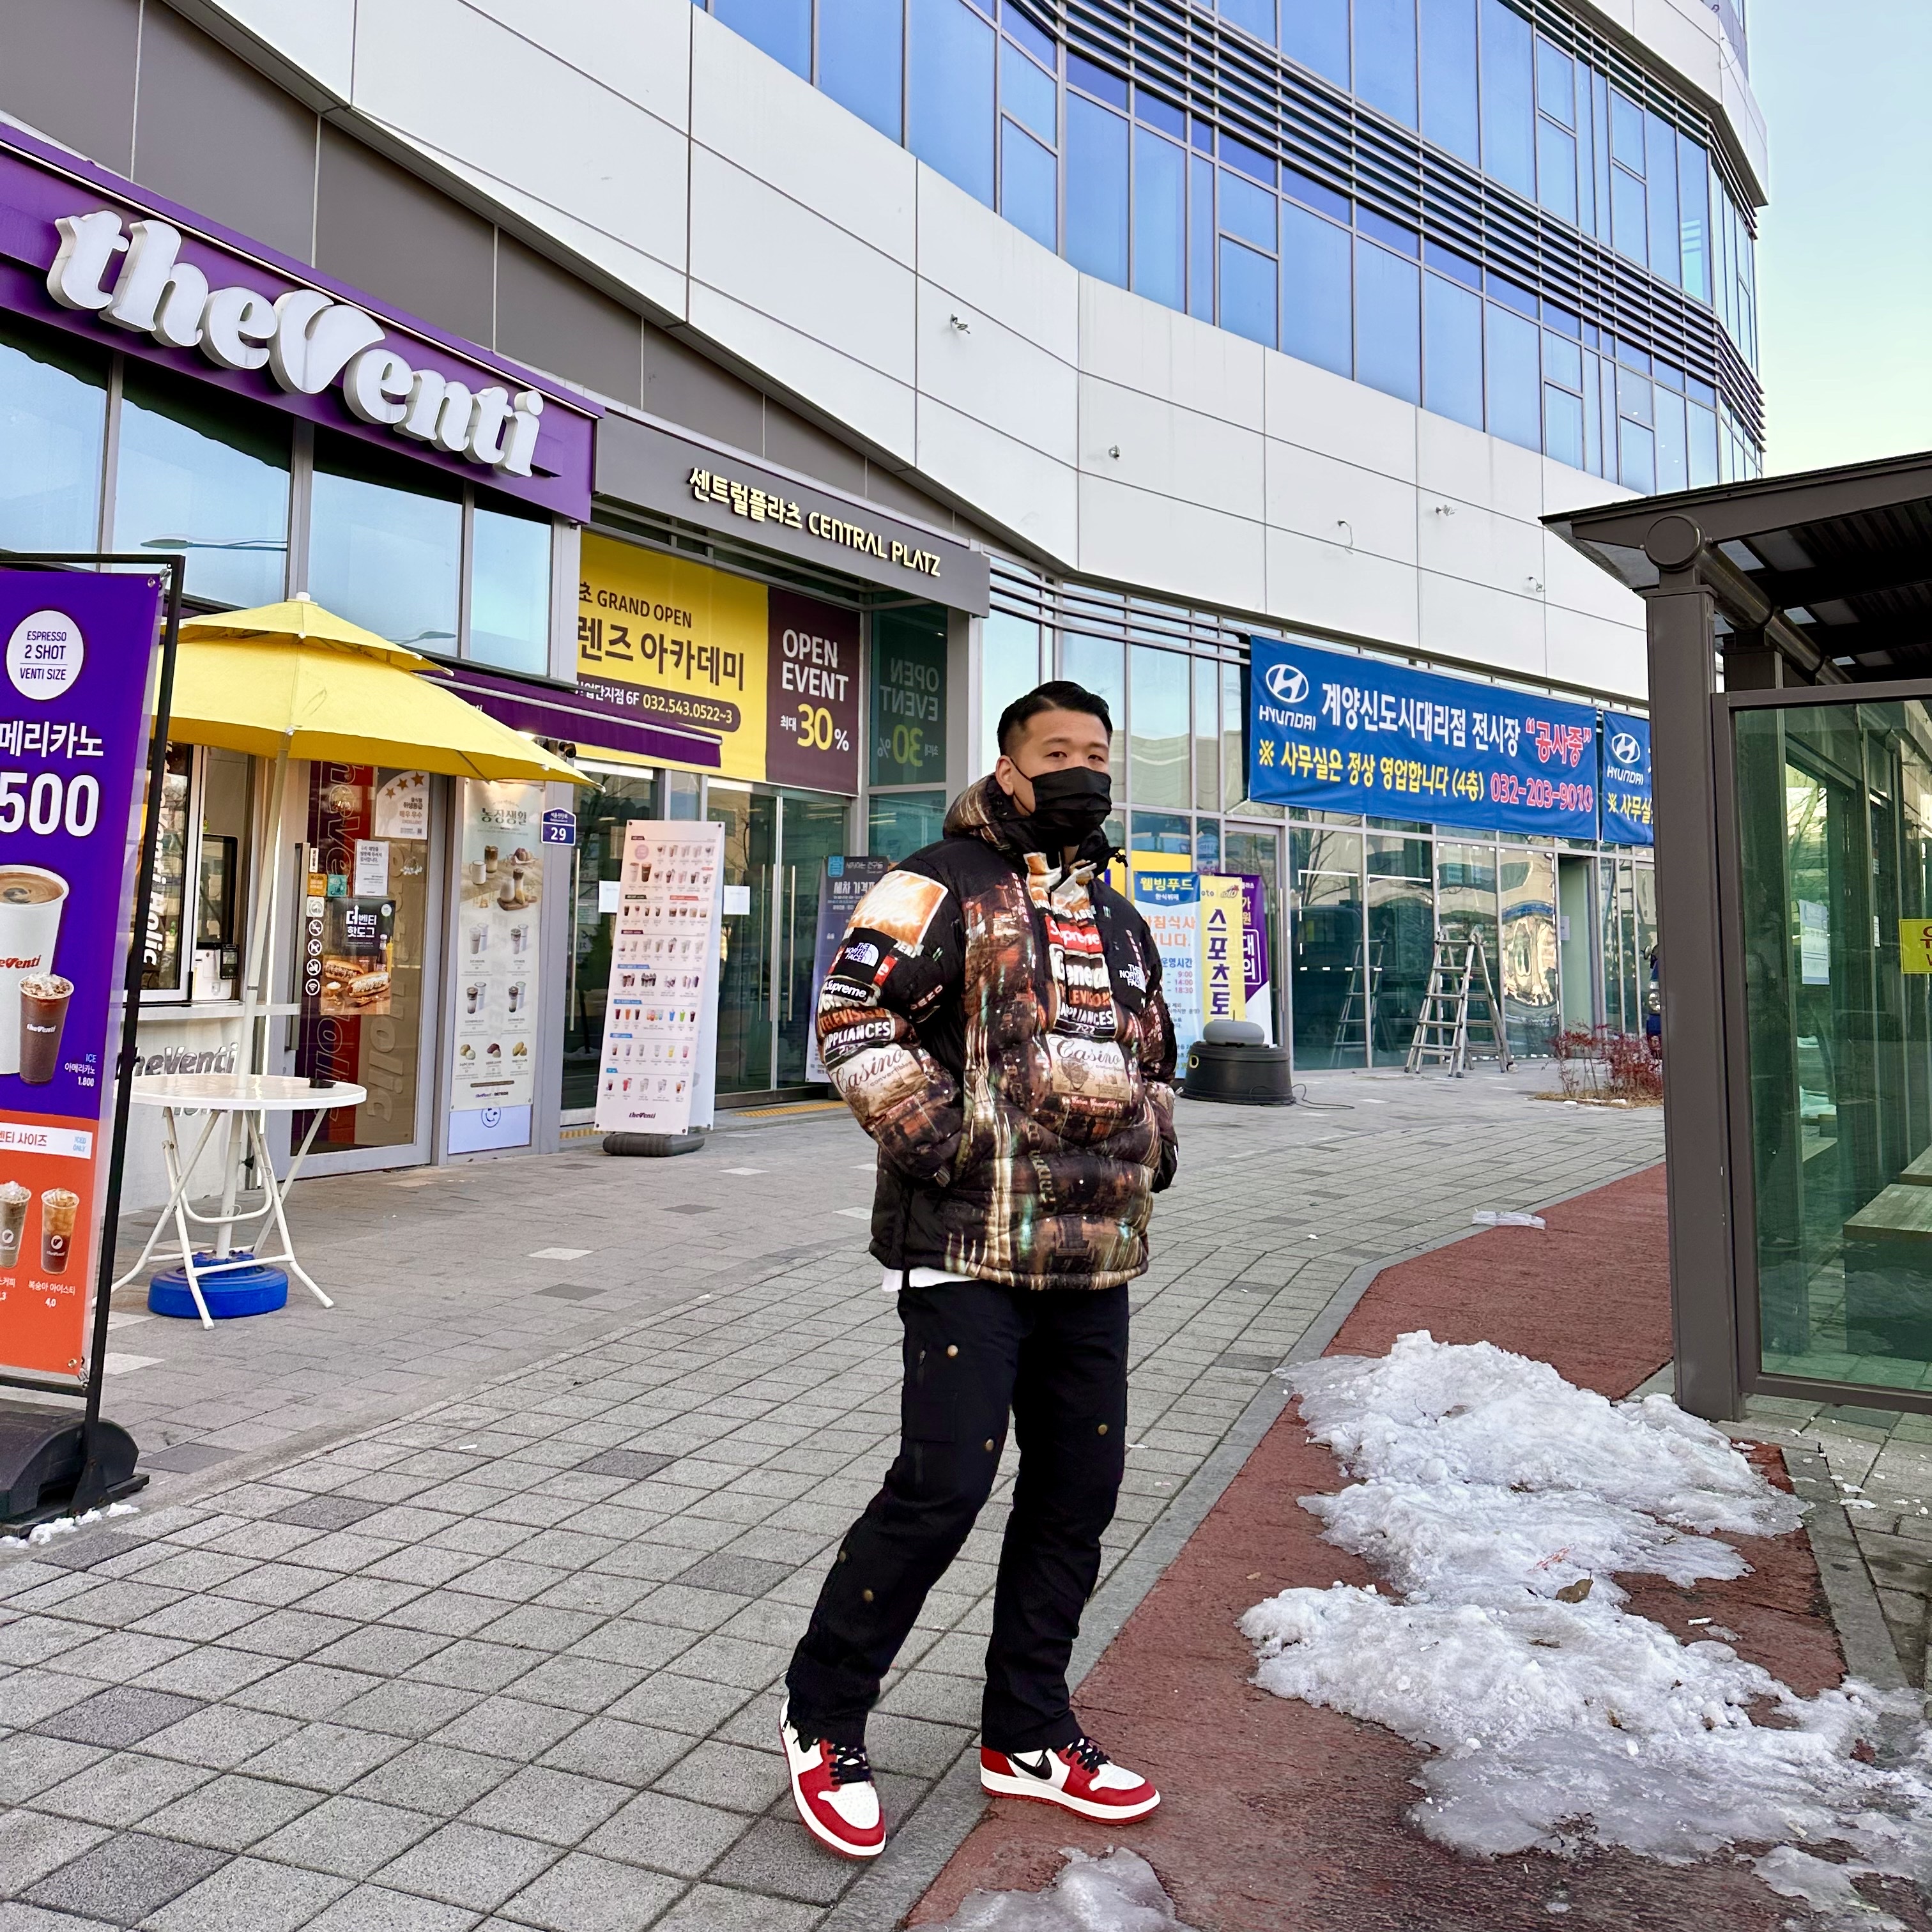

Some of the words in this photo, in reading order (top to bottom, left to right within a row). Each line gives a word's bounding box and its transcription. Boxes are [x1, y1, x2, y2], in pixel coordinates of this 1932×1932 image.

[47, 210, 544, 477] theVenti
[687, 466, 802, 529] 센트럴플라츠
[807, 512, 887, 558] CENTRAL
[890, 540, 940, 577] PLATZ
[597, 590, 650, 617] GRAND
[654, 604, 692, 628] OPEN
[27, 631, 66, 641] ESPRESSO
[24, 644, 33, 659] 2
[35, 645, 66, 659] SHOT
[578, 616, 633, 662] 렌즈
[641, 633, 744, 691] 아카데미
[782, 629, 838, 668] OPEN
[20, 667, 44, 679] VENTI
[47, 668, 66, 680] SIZE
[782, 661, 849, 702] EVENT
[626, 691, 640, 705] 6F
[643, 693, 733, 724] 032.543.0522~3
[1259, 705, 1316, 731] HYUNDAI
[780, 715, 797, 732] 최대
[797, 703, 849, 751] 30%
[1321, 683, 1466, 748] 계양신도시대리점
[1472, 712, 1521, 757] 전시장
[0, 720, 103, 758] 메리카노
[1280, 741, 1343, 783] 사무실은
[1347, 751, 1376, 788] 정상
[1380, 756, 1449, 797] 영업합니다
[1452, 768, 1485, 802] (4층)
[1490, 772, 1593, 813] 032-203-9010
[1607, 765, 1644, 786] HYUNDAI
[0, 772, 100, 837] 500
[1620, 794, 1653, 825] 사무실
[551, 827, 566, 841] 29
[1140, 877, 1193, 891] 웰빙푸드
[1242, 896, 1251, 910] 가
[346, 905, 377, 926] 더벤티
[1243, 912, 1252, 926] 원
[347, 926, 375, 938] 핫도그
[1154, 933, 1190, 947] 니다.
[845, 947, 866, 956] NORTH
[1243, 933, 1255, 956] 대
[845, 954, 863, 962] FACE
[1128, 963, 1140, 974] THE
[1162, 957, 1193, 968] 운영시간
[1207, 908, 1230, 1016] 스포츠토
[1244, 958, 1256, 980] 의
[86, 1054, 96, 1062] ICE
[65, 1063, 95, 1075] 아메리카노
[831, 1049, 904, 1094] Casino
[17, 1133, 47, 1146] 사이즈
[28, 1280, 49, 1292] 복숭아
[50, 1284, 75, 1296] 아이스티
